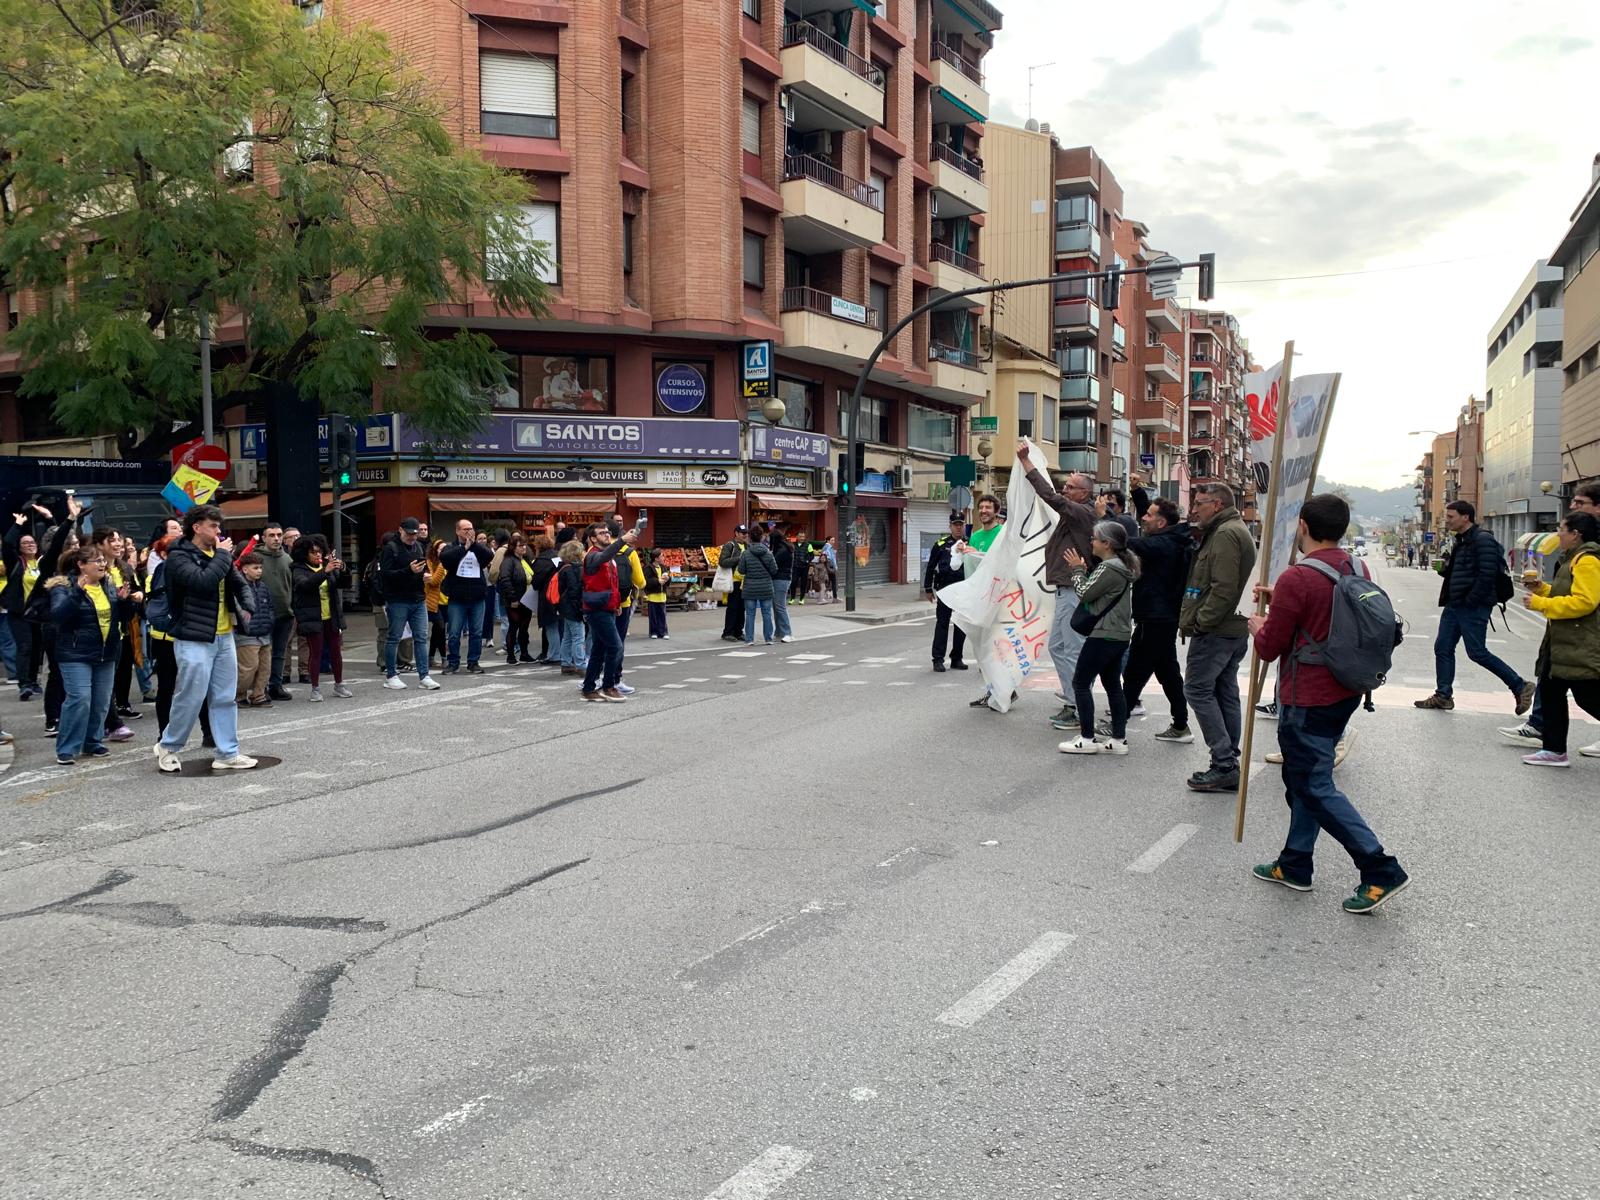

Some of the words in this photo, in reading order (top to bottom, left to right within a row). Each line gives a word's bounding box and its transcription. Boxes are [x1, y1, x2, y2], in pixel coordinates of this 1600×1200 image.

[667, 378, 696, 387] CURSOS
[660, 388, 703, 397] INTENSIVOS
[545, 423, 641, 441] SANTOS
[547, 441, 640, 450] AUTOESCOLES
[774, 437, 795, 449] centre
[795, 435, 809, 451] CAP
[37, 459, 142, 469] www.serhsdistribucio.com
[357, 469, 385, 480] VIURES
[420, 470, 447, 479] Fresh
[511, 470, 566, 480] COLMADO
[590, 471, 644, 480] QUEVIURES
[703, 473, 727, 482] Fresh
[751, 475, 776, 486] COLMADO
[785, 477, 806, 488] QUEVIURES
